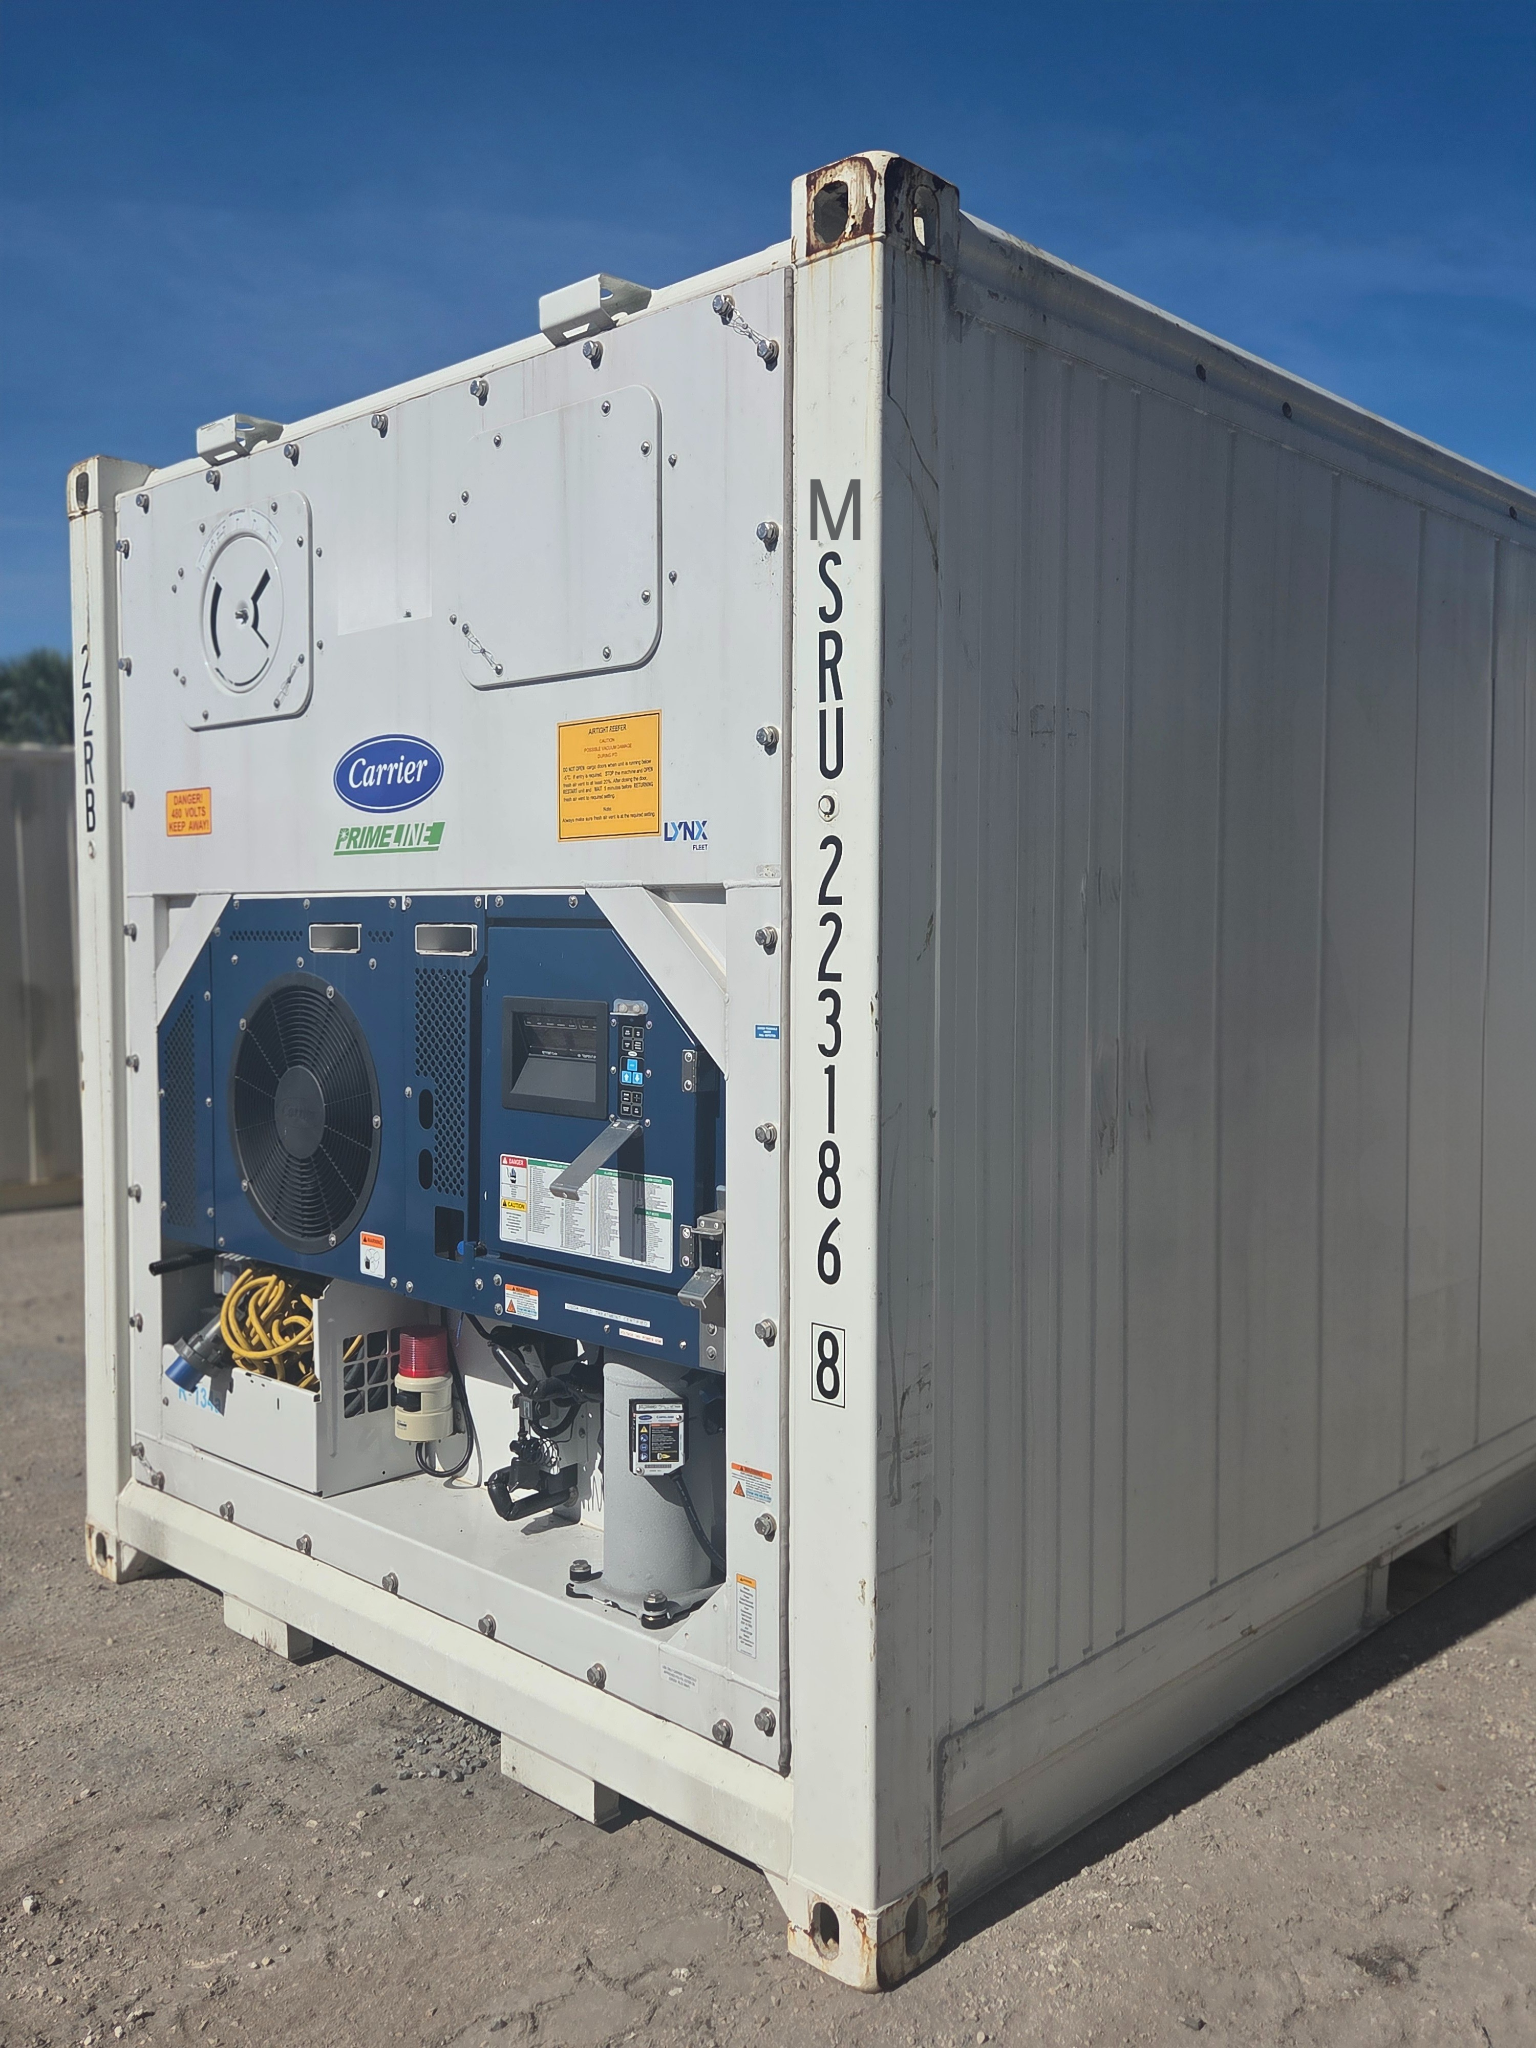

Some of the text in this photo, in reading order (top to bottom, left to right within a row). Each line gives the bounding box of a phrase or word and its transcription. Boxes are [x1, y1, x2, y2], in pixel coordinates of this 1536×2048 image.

[809, 478, 861, 780] MSRU
[588, 724, 627, 735] AIRTIGHT REEFER
[81, 644, 96, 833] 22RB
[348, 755, 428, 789] Carrier
[174, 793, 203, 806] DANGER!
[172, 806, 206, 818] 480 VOLTS
[169, 820, 209, 832] KEEP AWAY!
[664, 820, 708, 842] LYNX
[508, 1158, 524, 1166] DANGER
[508, 1202, 525, 1210] CAUTION
[817, 1330, 841, 1400] 8
